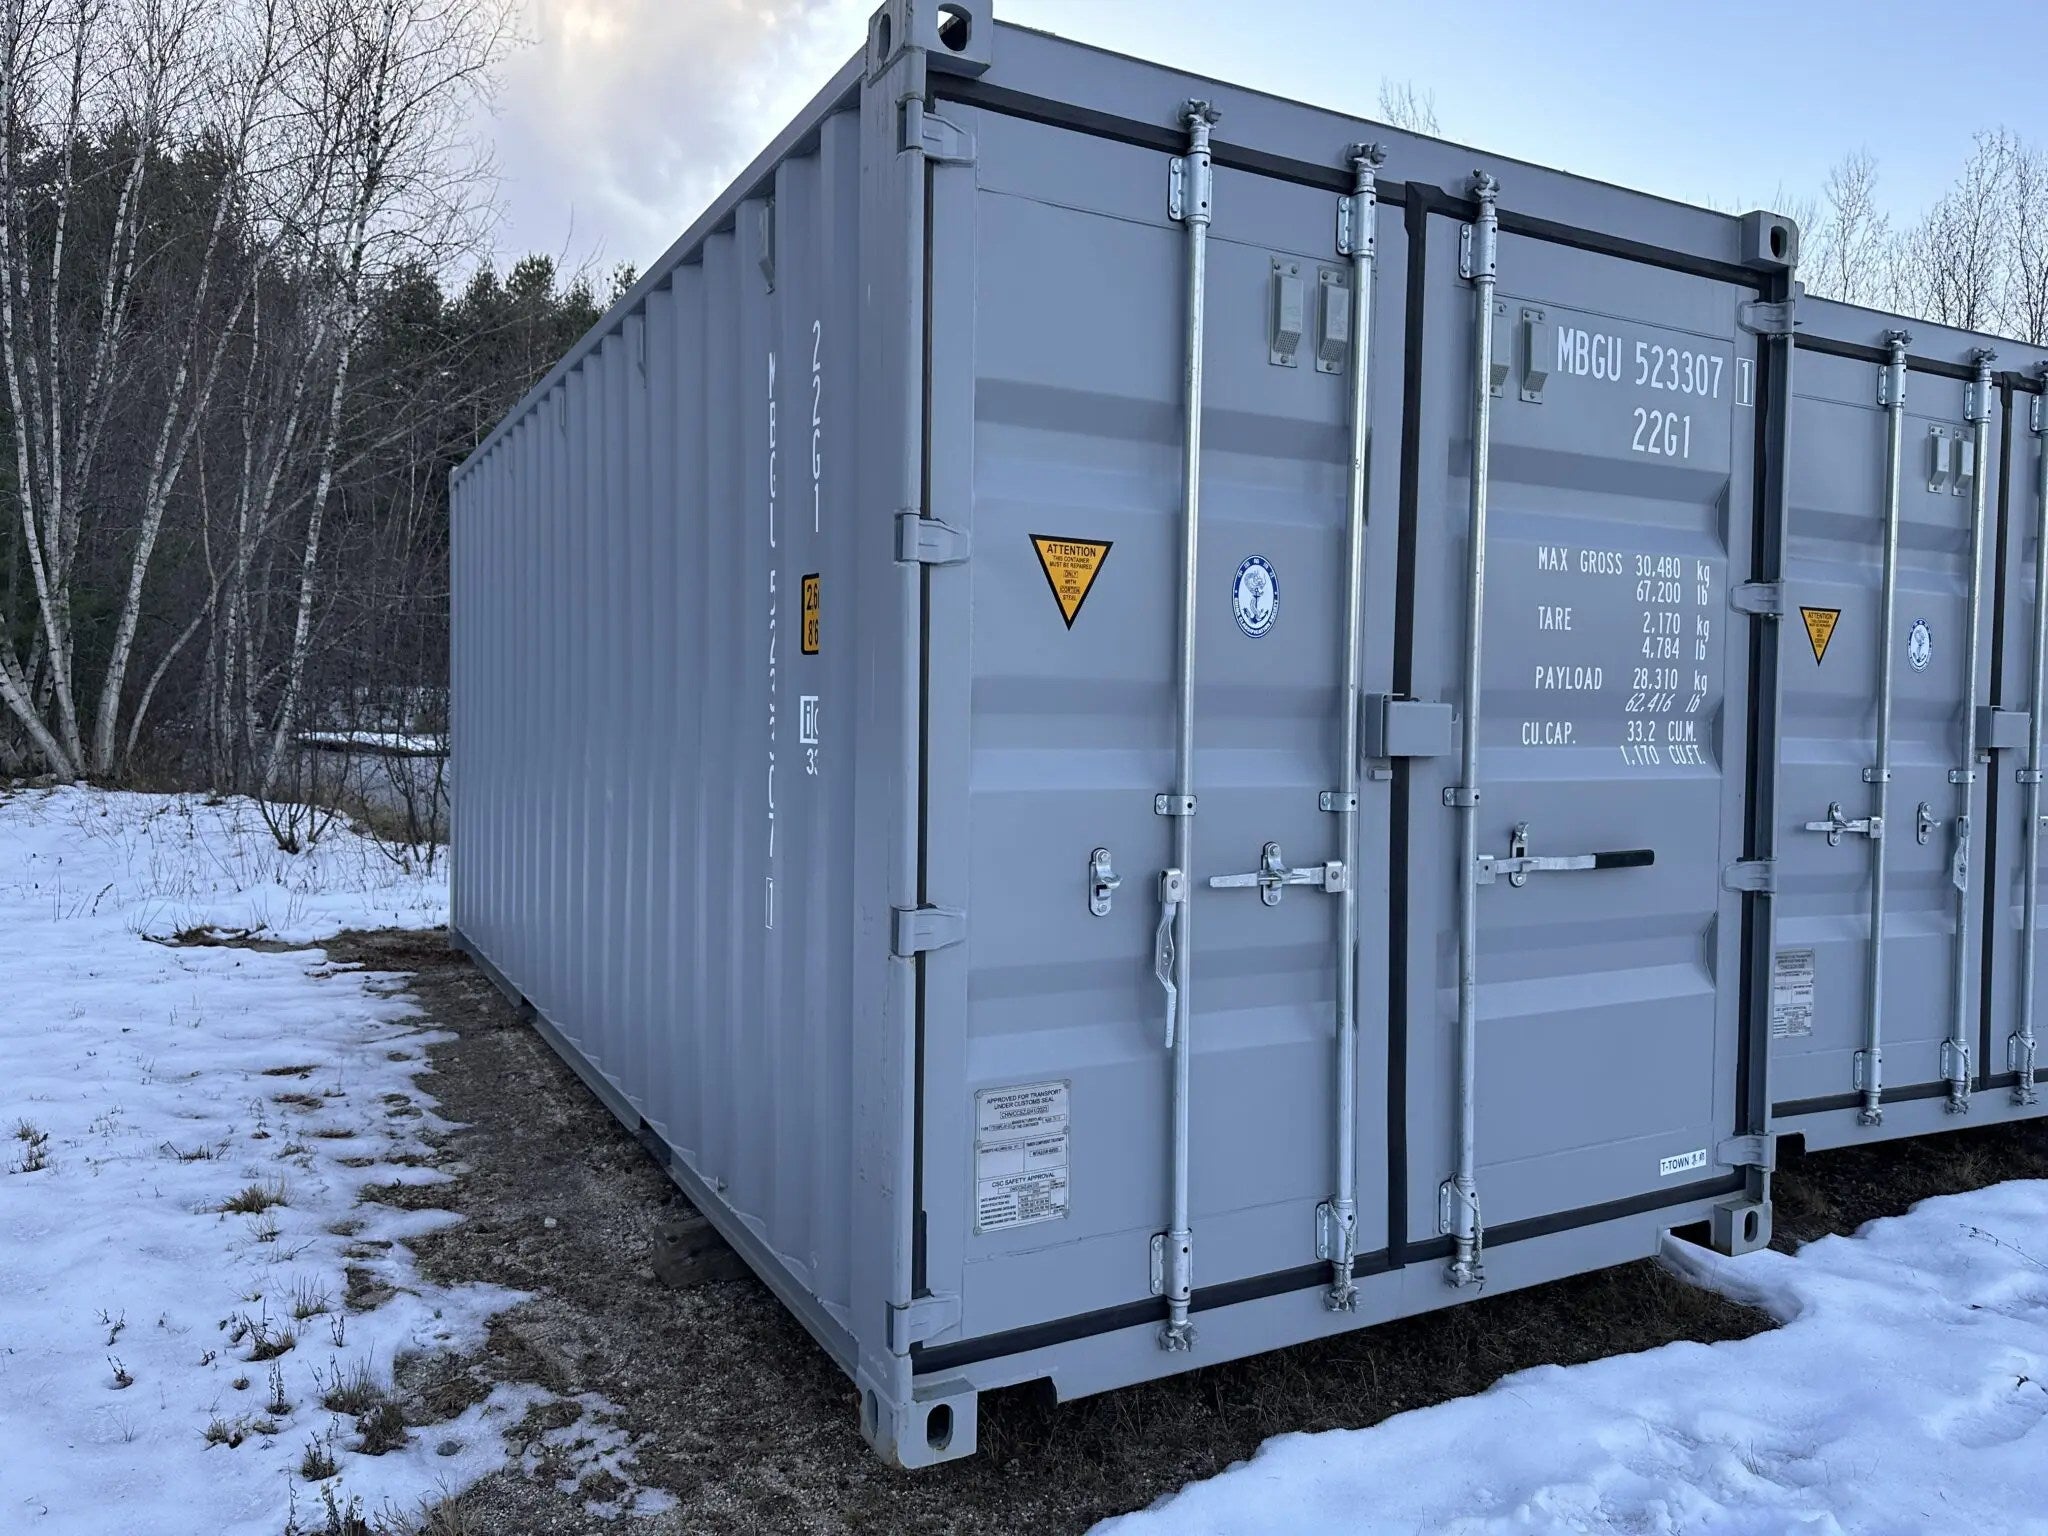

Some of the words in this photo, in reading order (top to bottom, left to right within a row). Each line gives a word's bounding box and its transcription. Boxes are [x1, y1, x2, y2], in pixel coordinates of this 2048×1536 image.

[1557, 326, 1622, 382] MBGU
[1635, 341, 1723, 398] 523307
[811, 320, 821, 533] 22G1
[1632, 407, 1690, 458] 22G1
[1046, 543, 1096, 557] ATTENTION
[1538, 546, 1568, 571] MAX
[1580, 550, 1623, 575] GROSS
[1635, 555, 1681, 579] 30,480
[1697, 560, 1710, 588] kg
[1636, 580, 1681, 604] 67,200
[1697, 584, 1708, 606] lb
[1538, 606, 1572, 631] TARE
[1643, 612, 1680, 634] 2,170
[1696, 615, 1710, 642] kg
[1808, 612, 1833, 620] ATTENTION
[1642, 636, 1680, 659] 4,784
[1695, 639, 1706, 660] lb
[1535, 666, 1603, 690] PAYLOAD
[1633, 668, 1678, 690] 28,310
[1694, 671, 1708, 697] kg
[1625, 693, 1675, 713] 62,416
[1685, 693, 1701, 713] lb
[1522, 722, 1576, 745] CU.CAP.
[1627, 721, 1656, 742] 33.2
[1668, 721, 1697, 742] CU.M.
[1620, 745, 1660, 766] 1,170
[987, 1095, 1017, 1105] APPROVED
[1018, 1093, 1030, 1101] FOR
[1030, 1088, 1062, 1098] TRANSPORT
[994, 1101, 1014, 1110] UNDER
[1014, 1098, 1041, 1107] CUSTOMS
[1041, 1096, 1054, 1104] SEAL
[1661, 1156, 1689, 1172] T-TOWN
[992, 1180, 1004, 1188] CSC
[1005, 1178, 1026, 1186] SAFETY
[1027, 1172, 1055, 1181] APPROVAL
